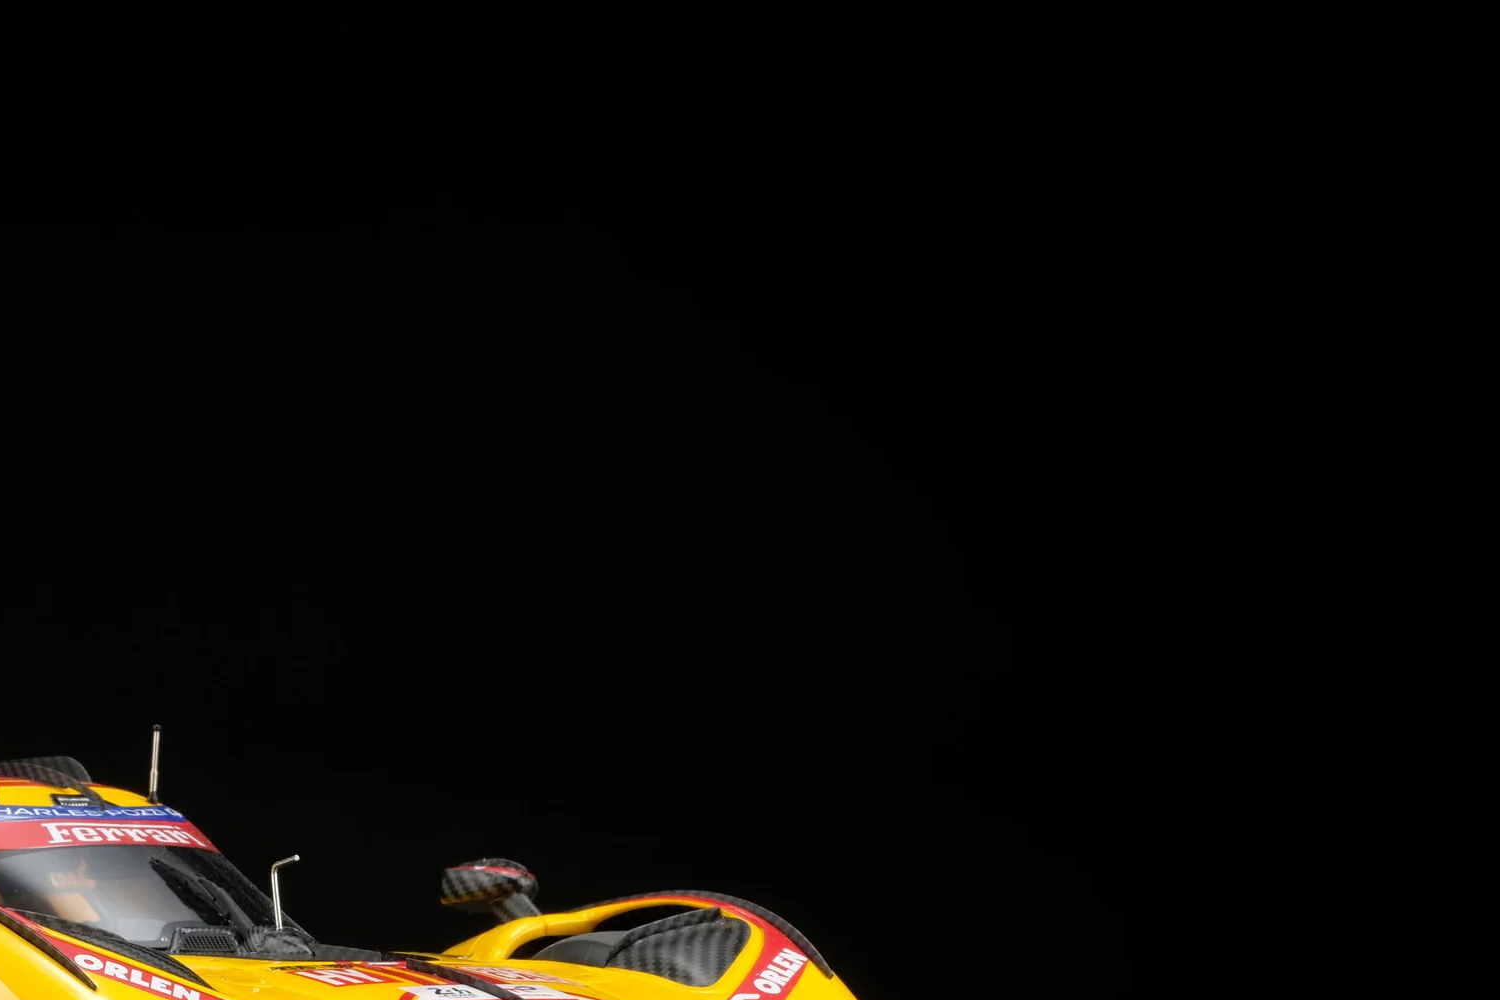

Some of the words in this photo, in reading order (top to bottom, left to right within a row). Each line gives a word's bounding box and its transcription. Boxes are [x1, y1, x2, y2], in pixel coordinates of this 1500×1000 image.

[104, 808, 168, 817] POZZI
[41, 822, 208, 847] Ferrari
[753, 948, 808, 994] ORLEN
